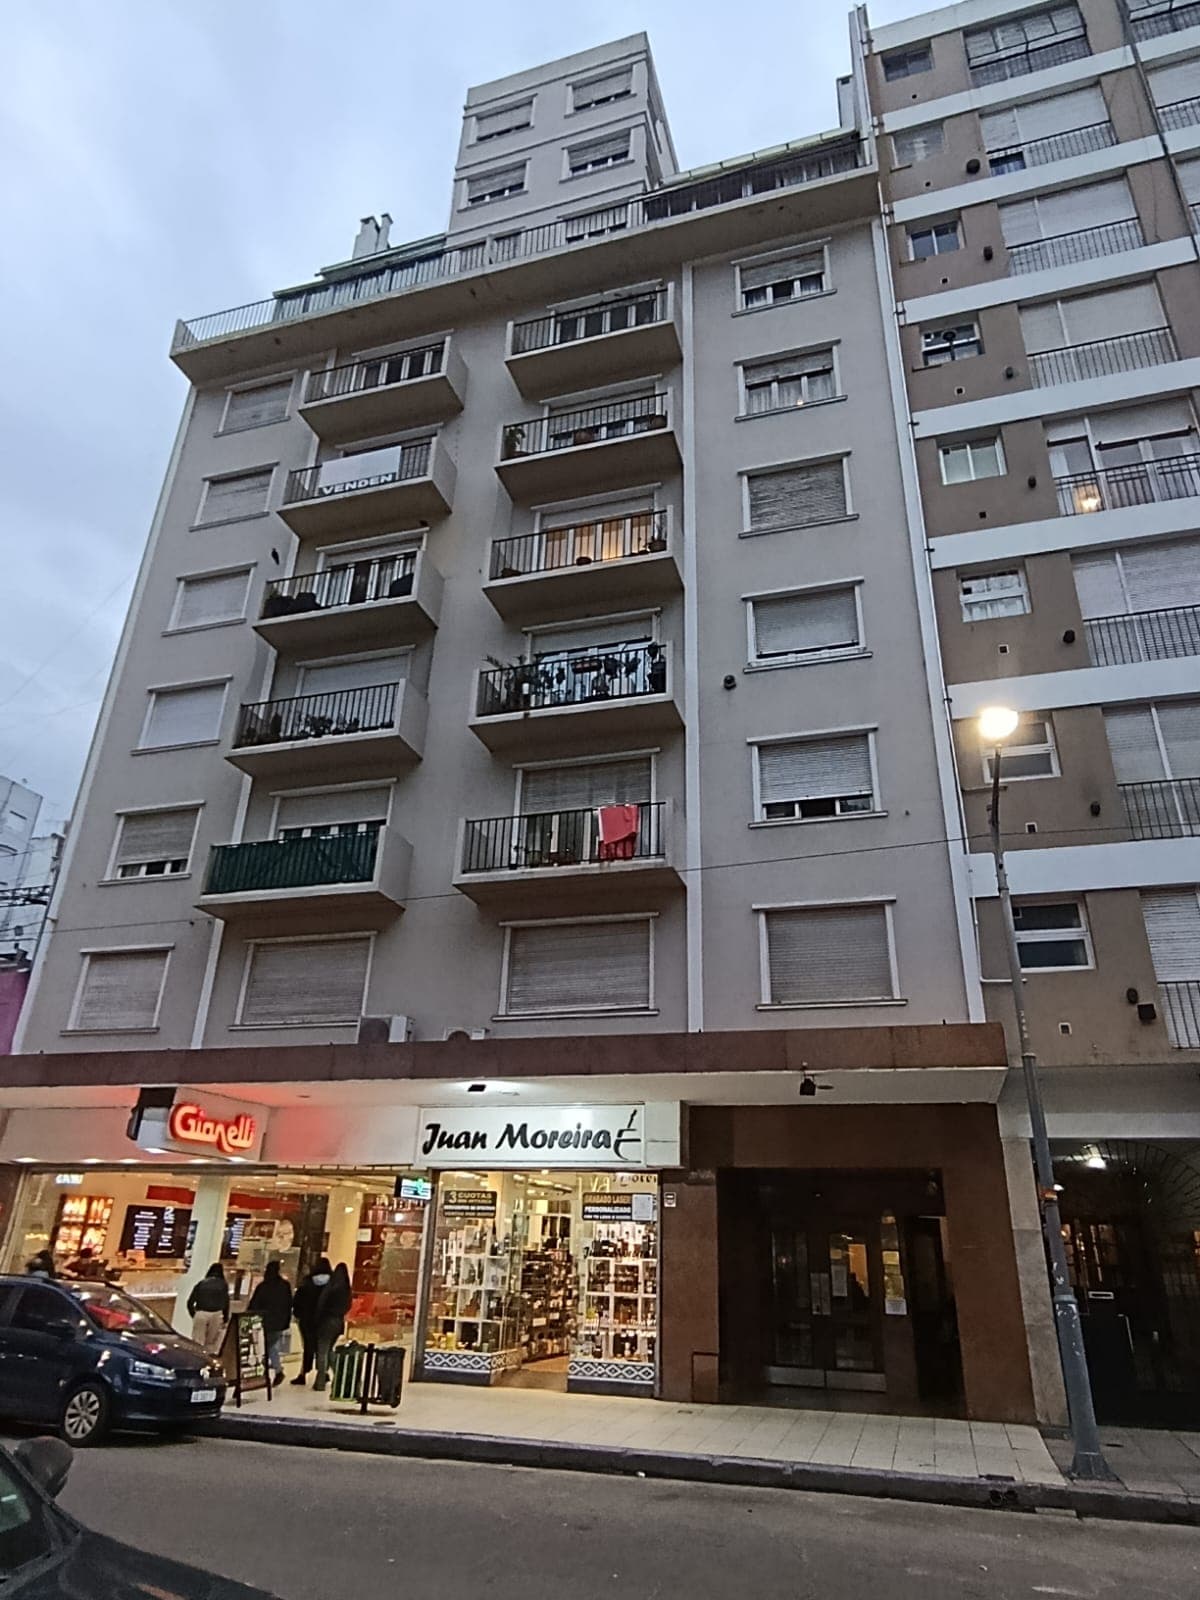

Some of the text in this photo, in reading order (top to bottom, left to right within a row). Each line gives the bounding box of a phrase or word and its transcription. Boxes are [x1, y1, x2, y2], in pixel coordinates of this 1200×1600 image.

[322, 473, 393, 495] VENDEN
[173, 1103, 256, 1153] Gianelli
[422, 1122, 612, 1155] Juan Moreira
[448, 1191, 457, 1204] 3
